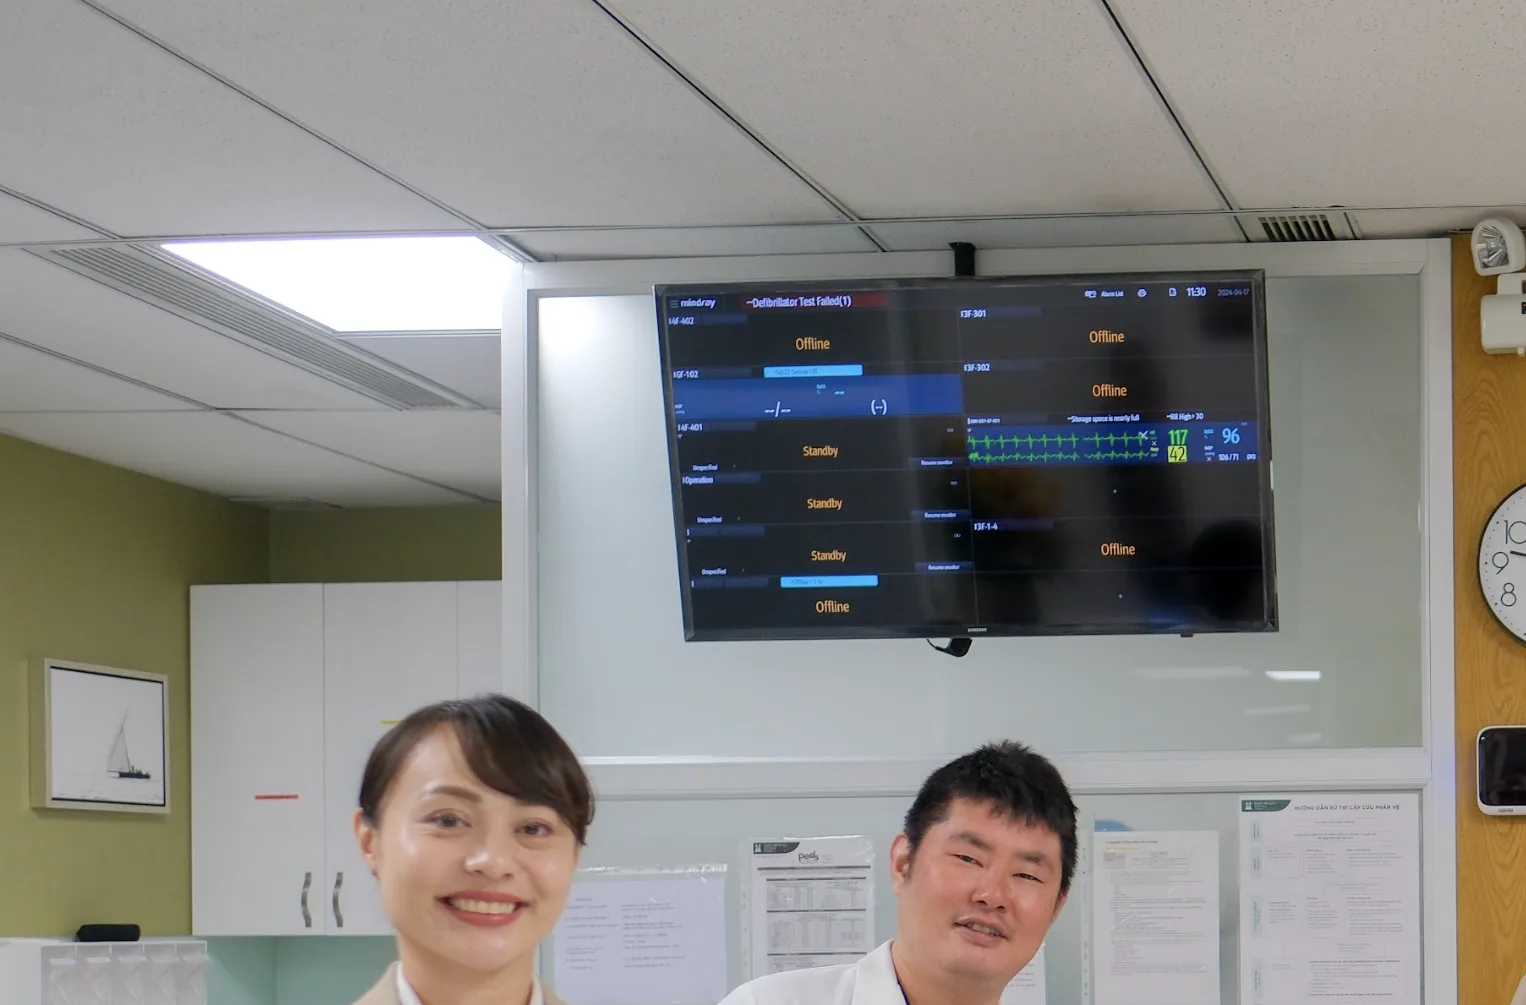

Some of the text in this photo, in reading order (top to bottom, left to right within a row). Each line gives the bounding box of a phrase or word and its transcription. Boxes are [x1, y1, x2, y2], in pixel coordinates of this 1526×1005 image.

[1186, 286, 1207, 297] 11:30
[680, 298, 716, 309] mindray
[799, 297, 816, 308] Test
[816, 295, 852, 308] Failed(1)
[1089, 330, 1125, 344] Offline
[795, 337, 831, 351] Offline
[1092, 384, 1128, 397] Offline
[1168, 429, 1188, 445] 117
[1222, 427, 1240, 444] 96
[802, 446, 839, 458] Standby
[1169, 446, 1186, 462] 42
[684, 476, 713, 485] Operation
[807, 499, 843, 510] Standby
[811, 550, 846, 562] Standby
[1100, 543, 1136, 556] Offline
[1492, 551, 1510, 575] 9
[1500, 582, 1517, 607] 8
[815, 601, 850, 614] Offline
